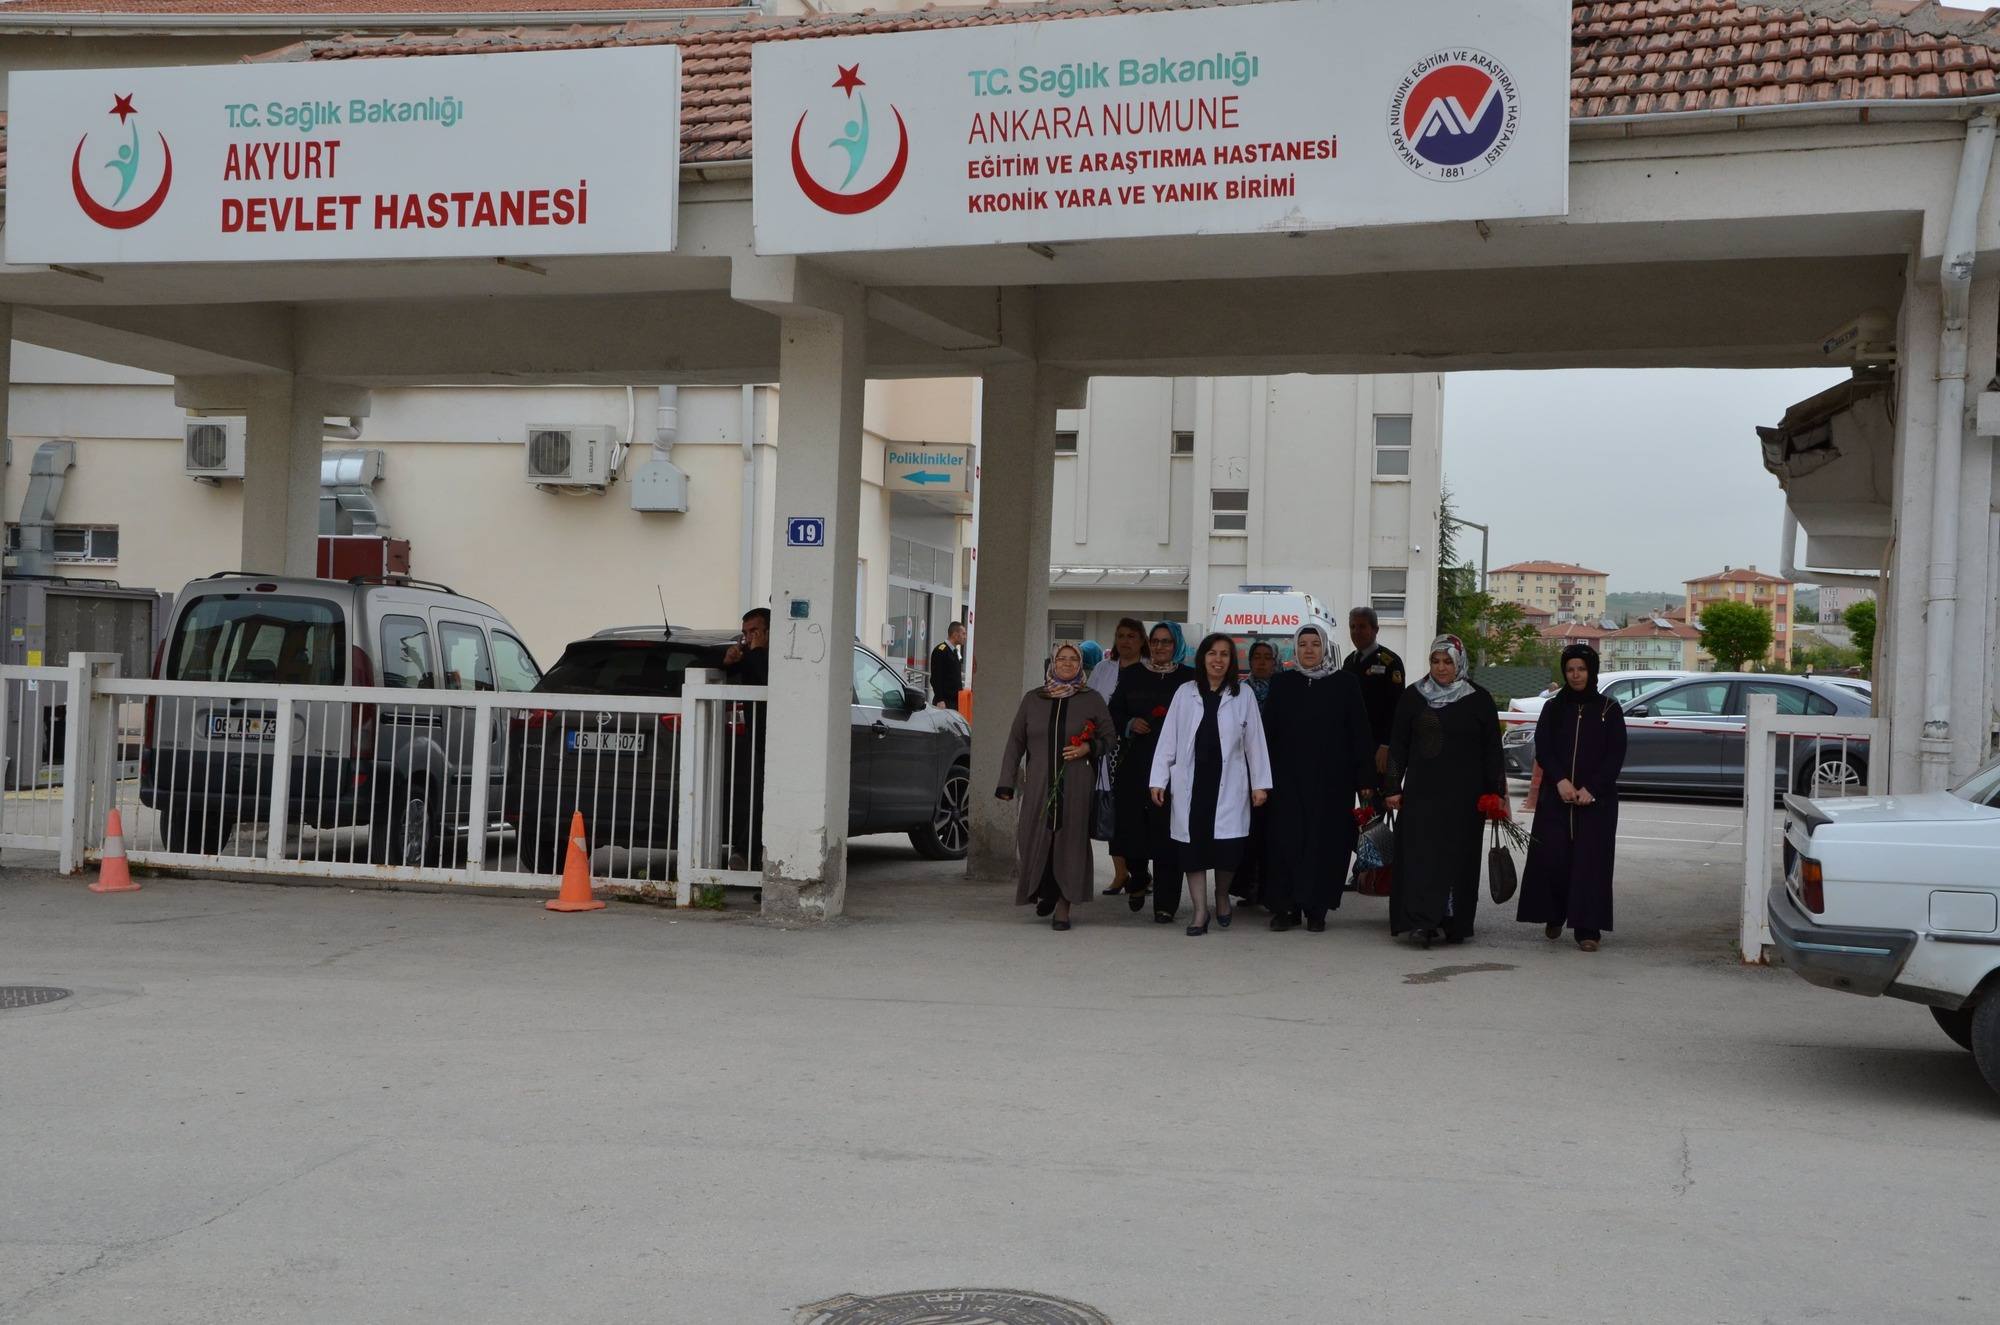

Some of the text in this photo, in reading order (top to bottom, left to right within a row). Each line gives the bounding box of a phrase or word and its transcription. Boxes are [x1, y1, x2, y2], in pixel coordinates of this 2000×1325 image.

[968, 51, 1259, 98] T.C. Sağlık Bakanlığı
[1453, 51, 1467, 62] VE
[224, 96, 464, 132] T.C. Sağlık Bakanlığı
[968, 96, 1239, 145] ANKARA NUMUNE
[1390, 76, 1414, 126] NUMUNE
[223, 140, 341, 181] AKYURT
[968, 134, 1337, 179] EĞİTİM VE ARAŞTIRMA HASTANESİ
[1392, 128, 1424, 170] ANKARA
[1440, 166, 1465, 178] 1881
[221, 179, 587, 232] DEVLET HASTANESİ
[968, 173, 1295, 213] KRONİK YARA VE YANIK BİRİMİ
[889, 452, 964, 466] Poliklinikler
[797, 524, 816, 542] 19
[1224, 614, 1300, 626] AMBULANS
[784, 622, 826, 664] 19
